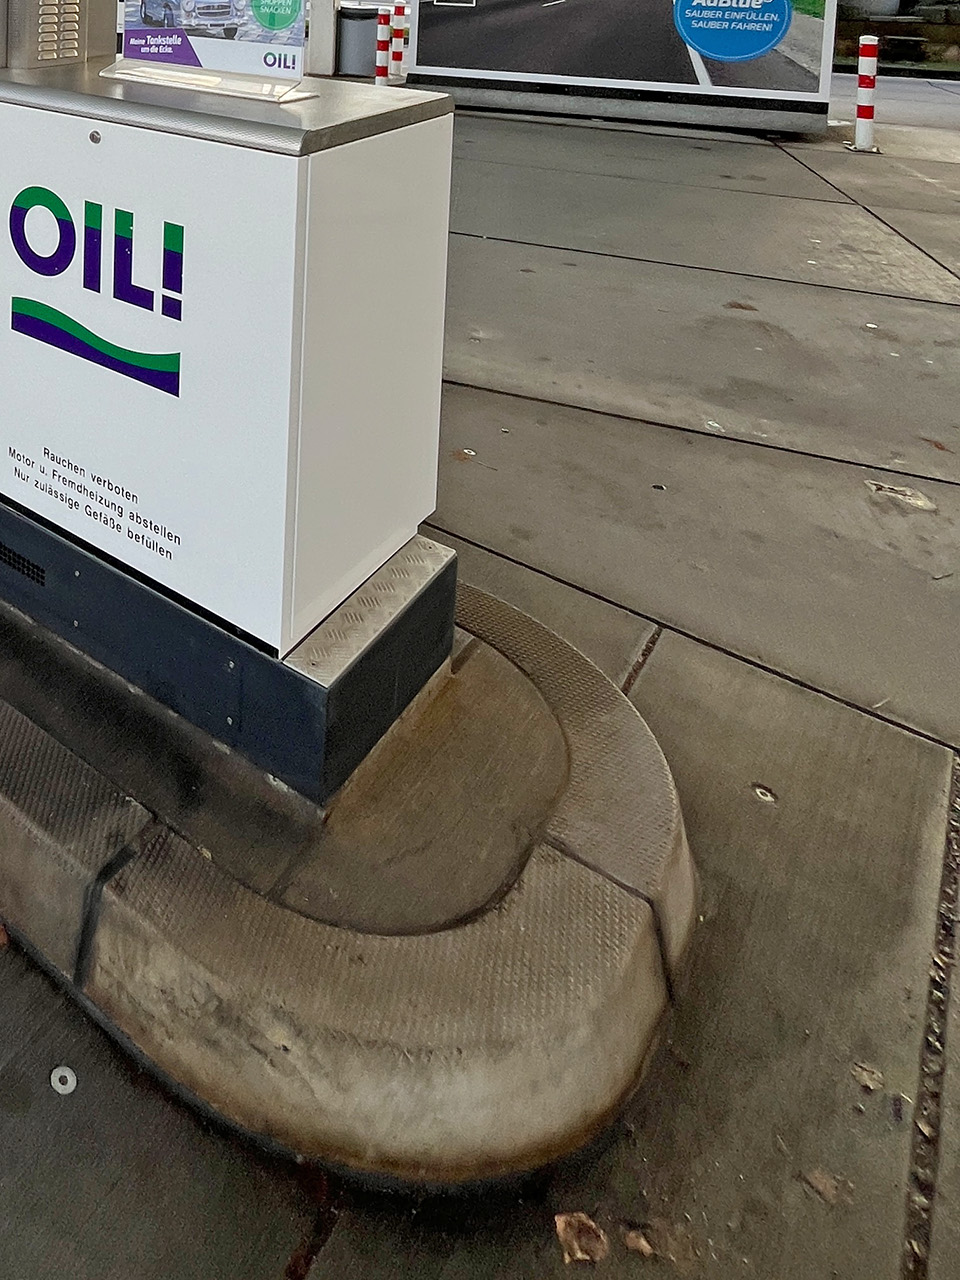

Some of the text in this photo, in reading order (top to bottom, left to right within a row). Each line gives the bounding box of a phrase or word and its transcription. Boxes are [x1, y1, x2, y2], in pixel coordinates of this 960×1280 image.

[259, 5, 292, 15] SNACKEN
[685, 9, 780, 22] SAUBER EINFÜLLEN,
[691, 20, 773, 32] SAUBER FAHREN!
[146, 35, 182, 45] Tankstelle
[263, 52, 296, 70] OIL!
[9, 186, 184, 321] OIL!
[42, 447, 139, 505] Rauchen verboten
[8, 446, 182, 546] Motor u. Fremdheizung abstellen
[13, 466, 173, 561] Nur zulässige Gefäße befüllen
